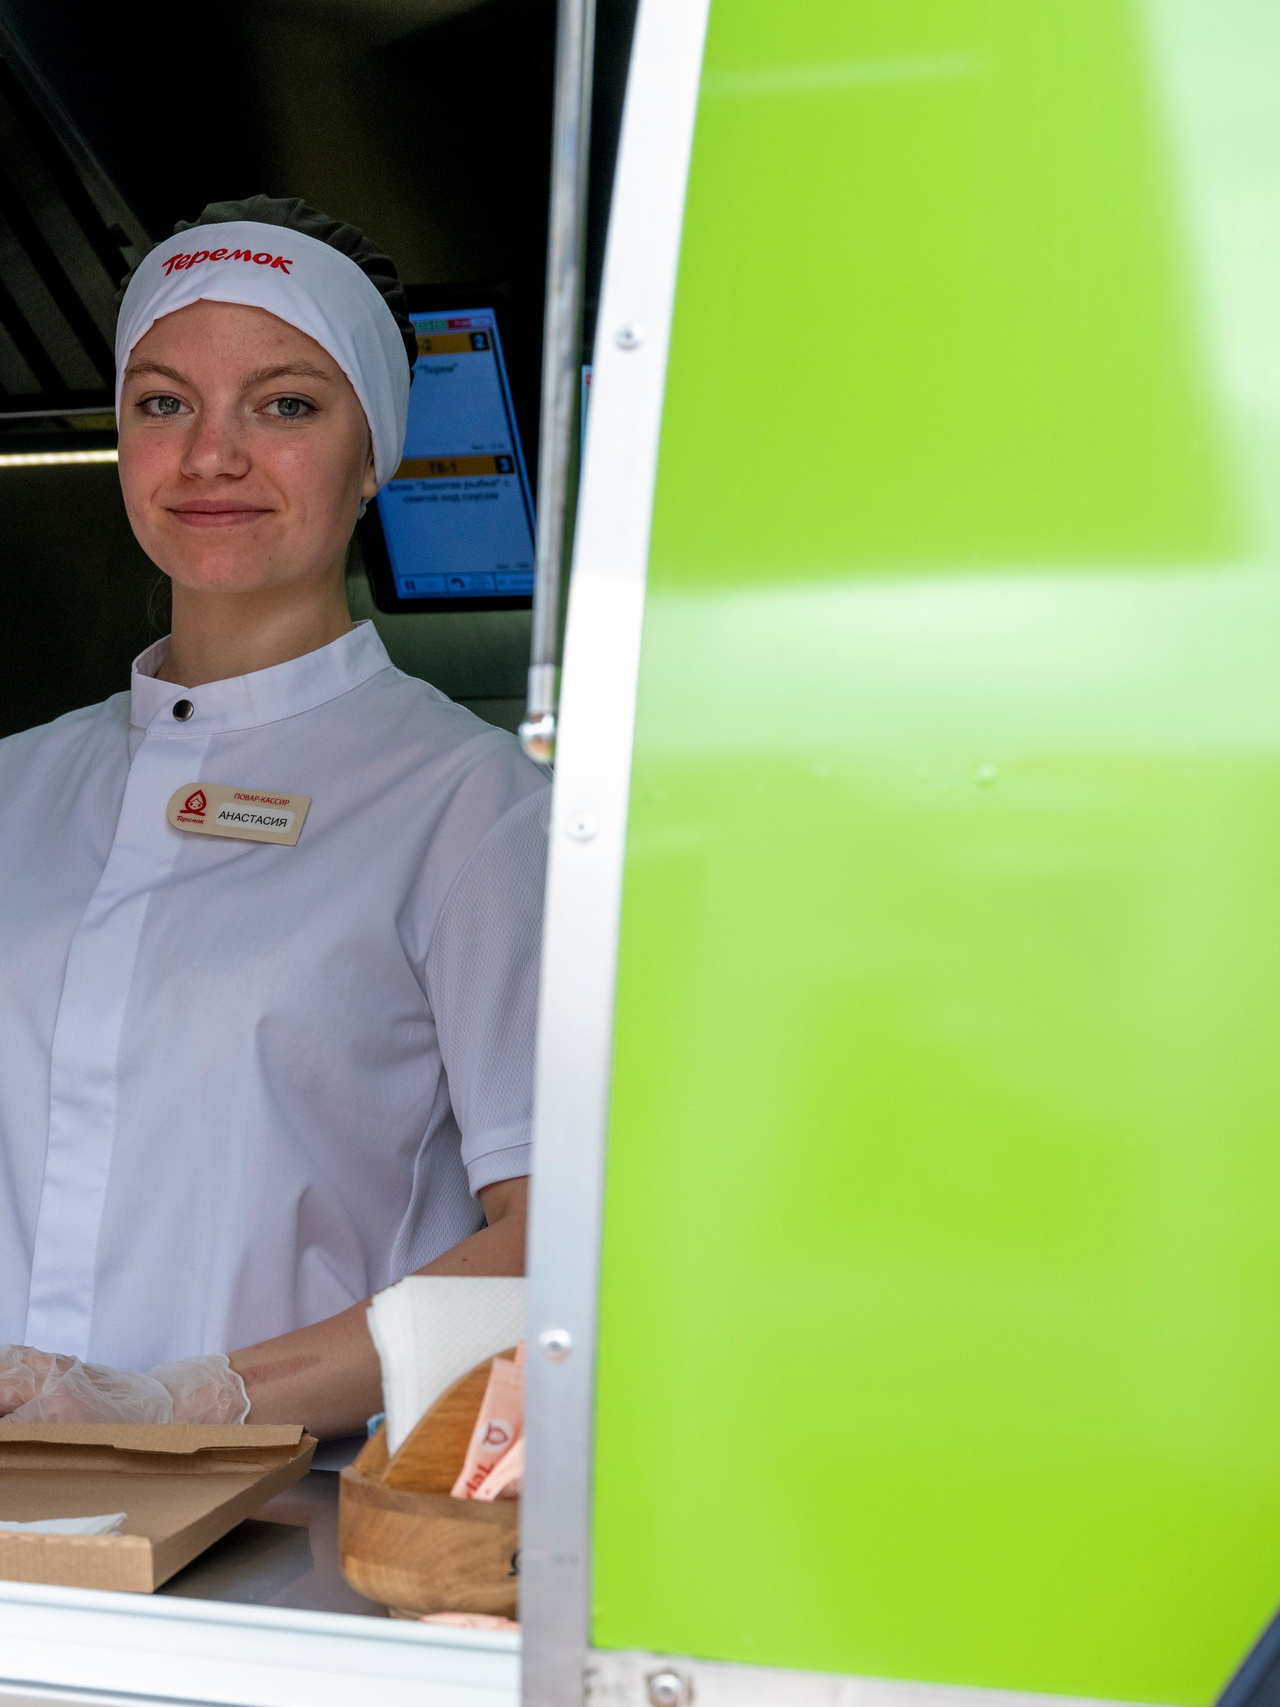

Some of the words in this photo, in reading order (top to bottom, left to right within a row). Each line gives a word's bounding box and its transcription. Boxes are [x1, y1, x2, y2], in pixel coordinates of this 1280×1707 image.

[161, 248, 293, 277] Теремок
[473, 334, 486, 349] 2
[233, 792, 290, 806] ПОВАР-КАССИР
[218, 810, 288, 828] АНАСТАСИЯ
